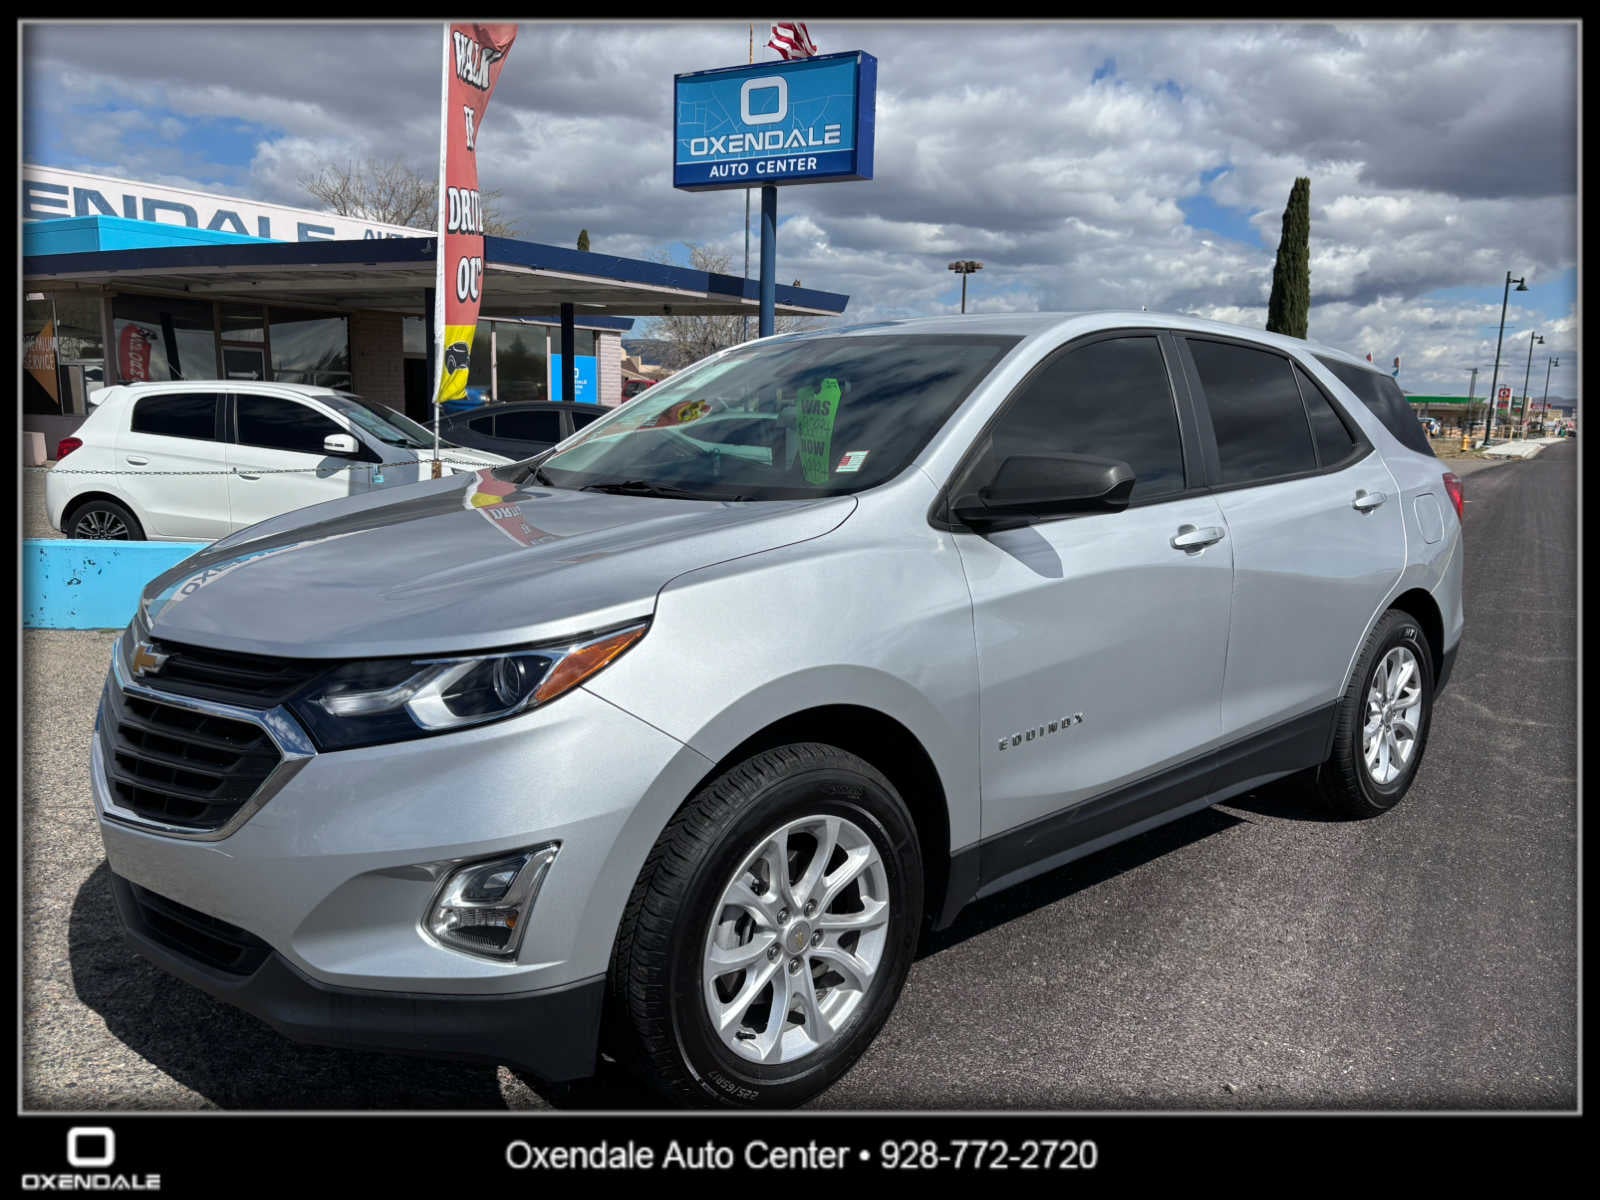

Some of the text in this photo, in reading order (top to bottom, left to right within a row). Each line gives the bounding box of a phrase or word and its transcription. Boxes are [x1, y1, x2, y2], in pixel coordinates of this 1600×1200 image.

[452, 30, 502, 91] WALK
[690, 123, 841, 156] OXENDALE
[709, 157, 817, 178] AUTO CENTER
[801, 400, 831, 416] WAS
[998, 711, 1084, 752] EQUINOX
